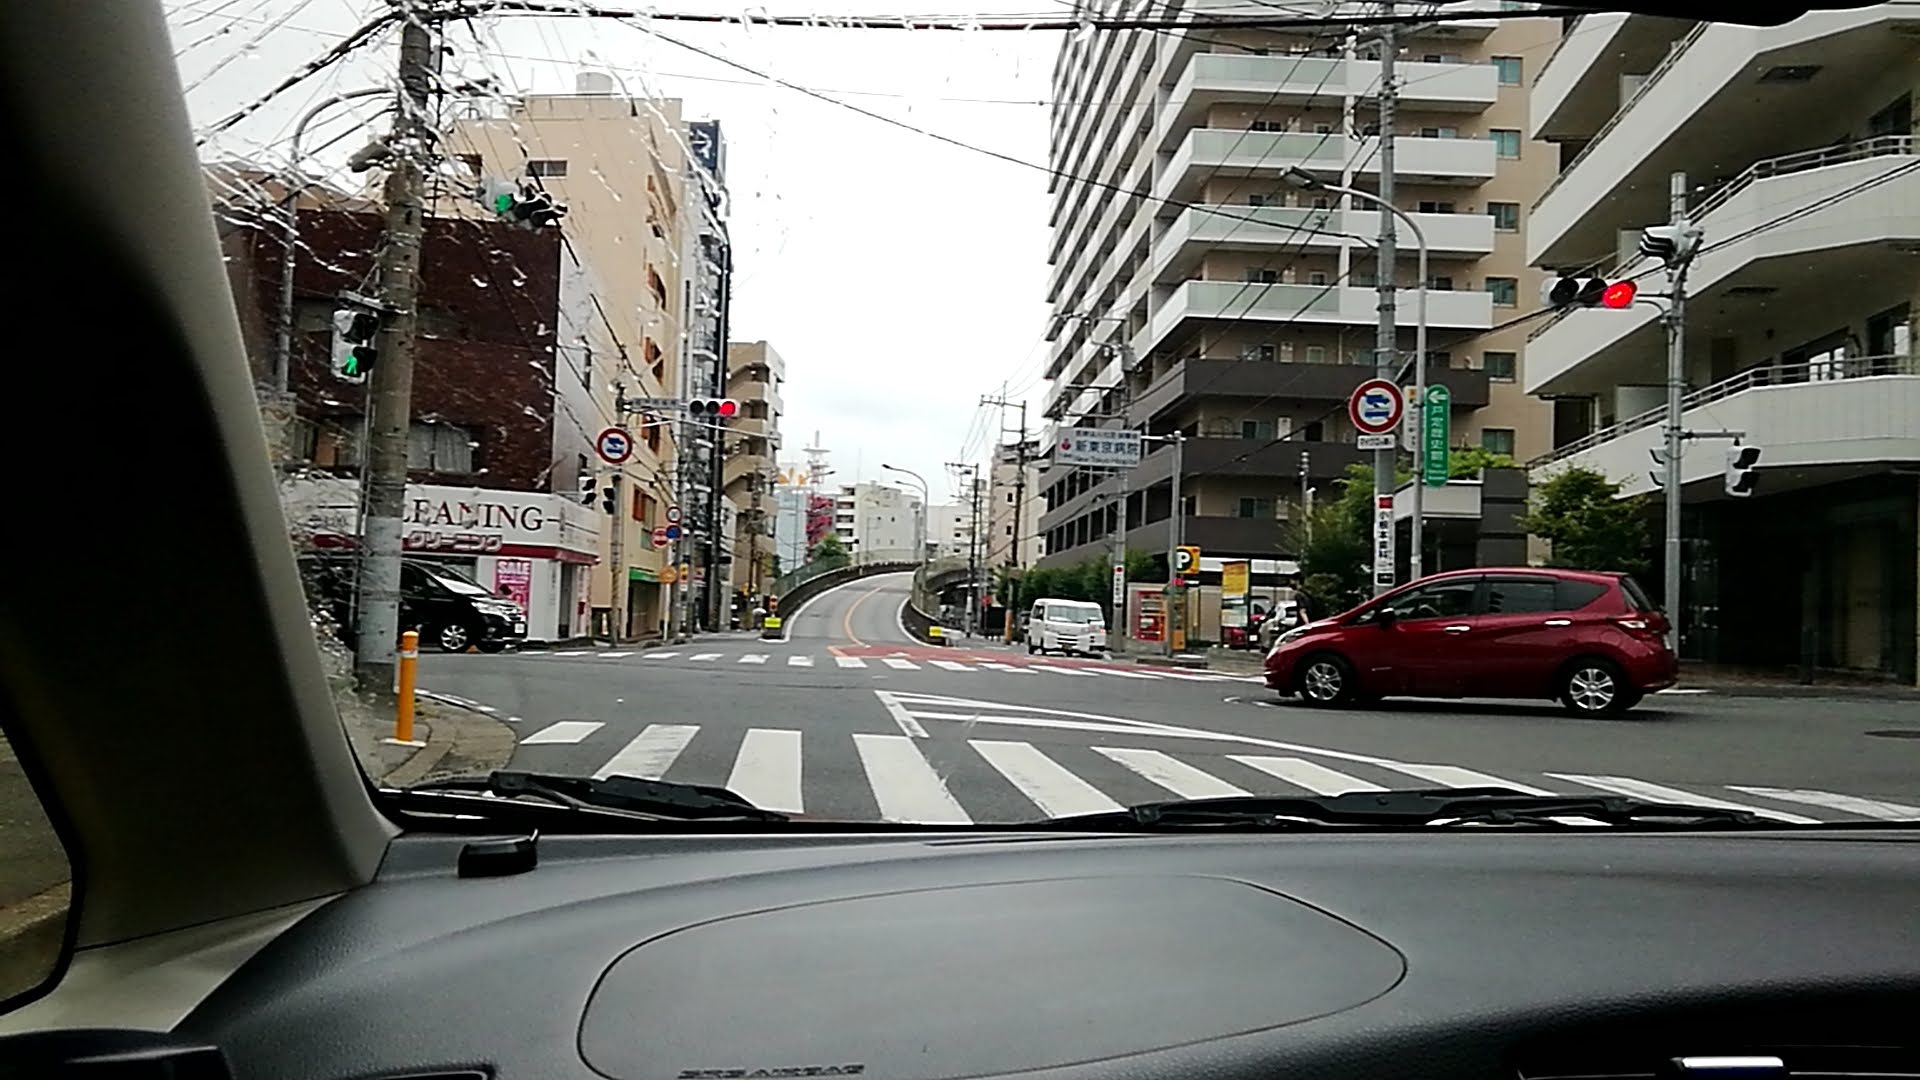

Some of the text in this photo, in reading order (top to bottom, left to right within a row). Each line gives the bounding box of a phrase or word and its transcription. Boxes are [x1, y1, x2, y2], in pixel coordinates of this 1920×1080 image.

[1430, 405, 1444, 461] 戸定歴史館
[1076, 439, 1138, 455] 新東京病院
[408, 530, 502, 551] クリーニング
[497, 560, 530, 575] SALE
